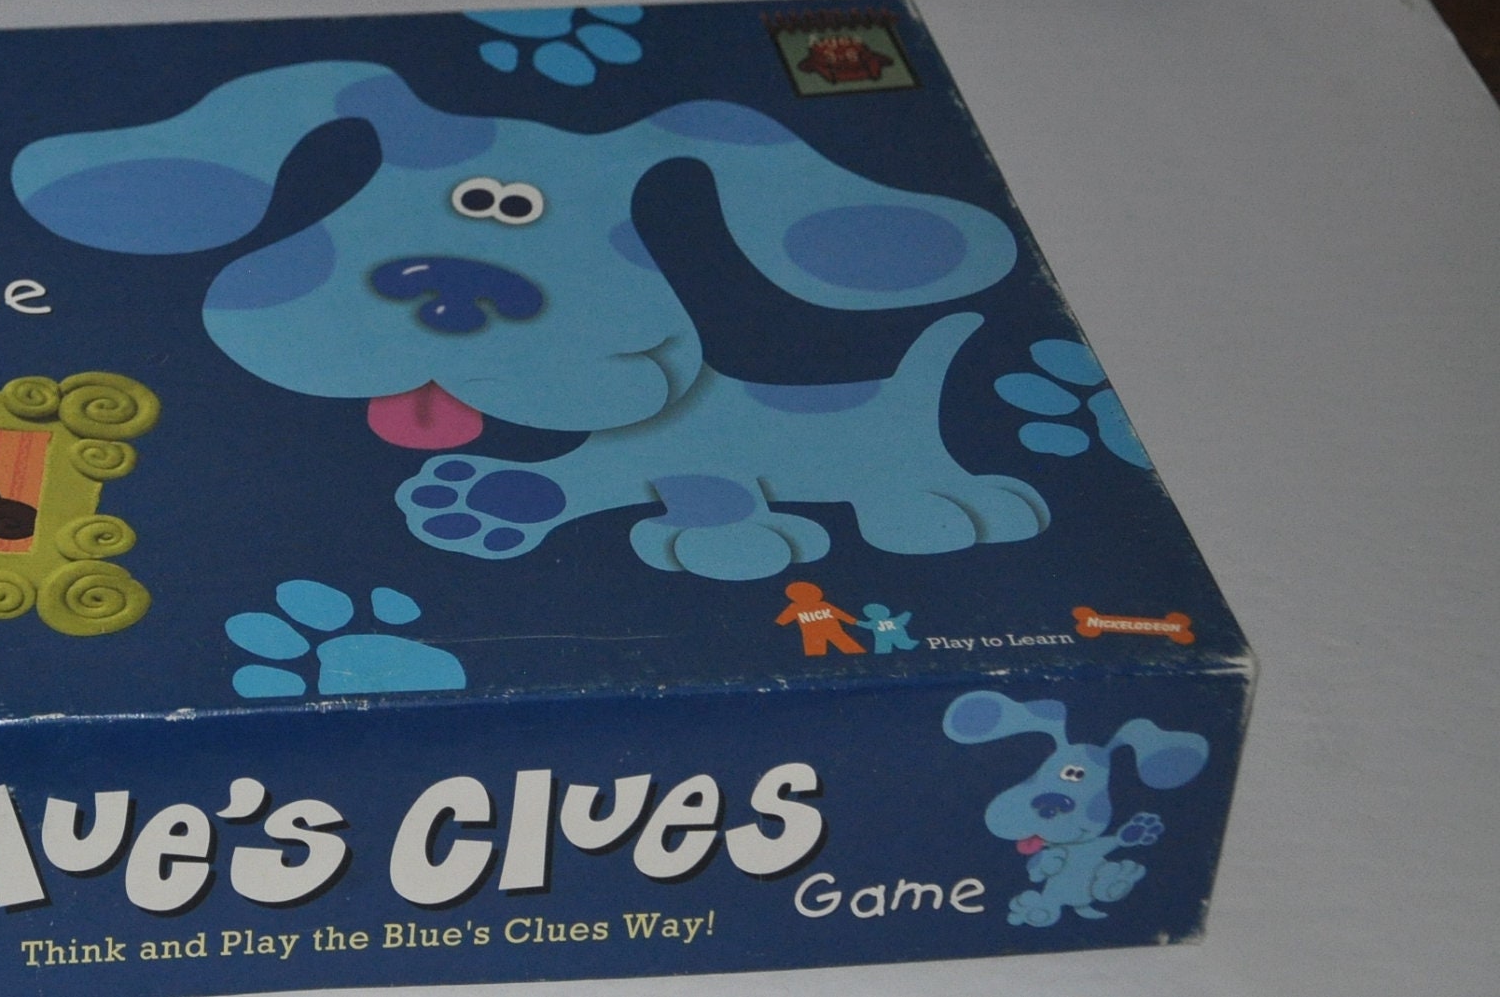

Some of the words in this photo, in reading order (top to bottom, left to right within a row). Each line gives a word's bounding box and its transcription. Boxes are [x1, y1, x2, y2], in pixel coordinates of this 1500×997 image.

[797, 607, 834, 625] NICK
[877, 619, 896, 632] JR
[929, 635, 974, 652] Play
[979, 634, 1003, 648] to
[1010, 632, 1075, 647] Learn
[389, 762, 823, 904] Clues
[794, 872, 986, 919] Game
[21, 936, 125, 967] Think
[140, 932, 208, 960] and
[220, 928, 300, 960] Play
[313, 925, 370, 951] the
[382, 921, 491, 949] Blue's
[504, 916, 609, 945] Clues
[623, 910, 717, 945] Way!
